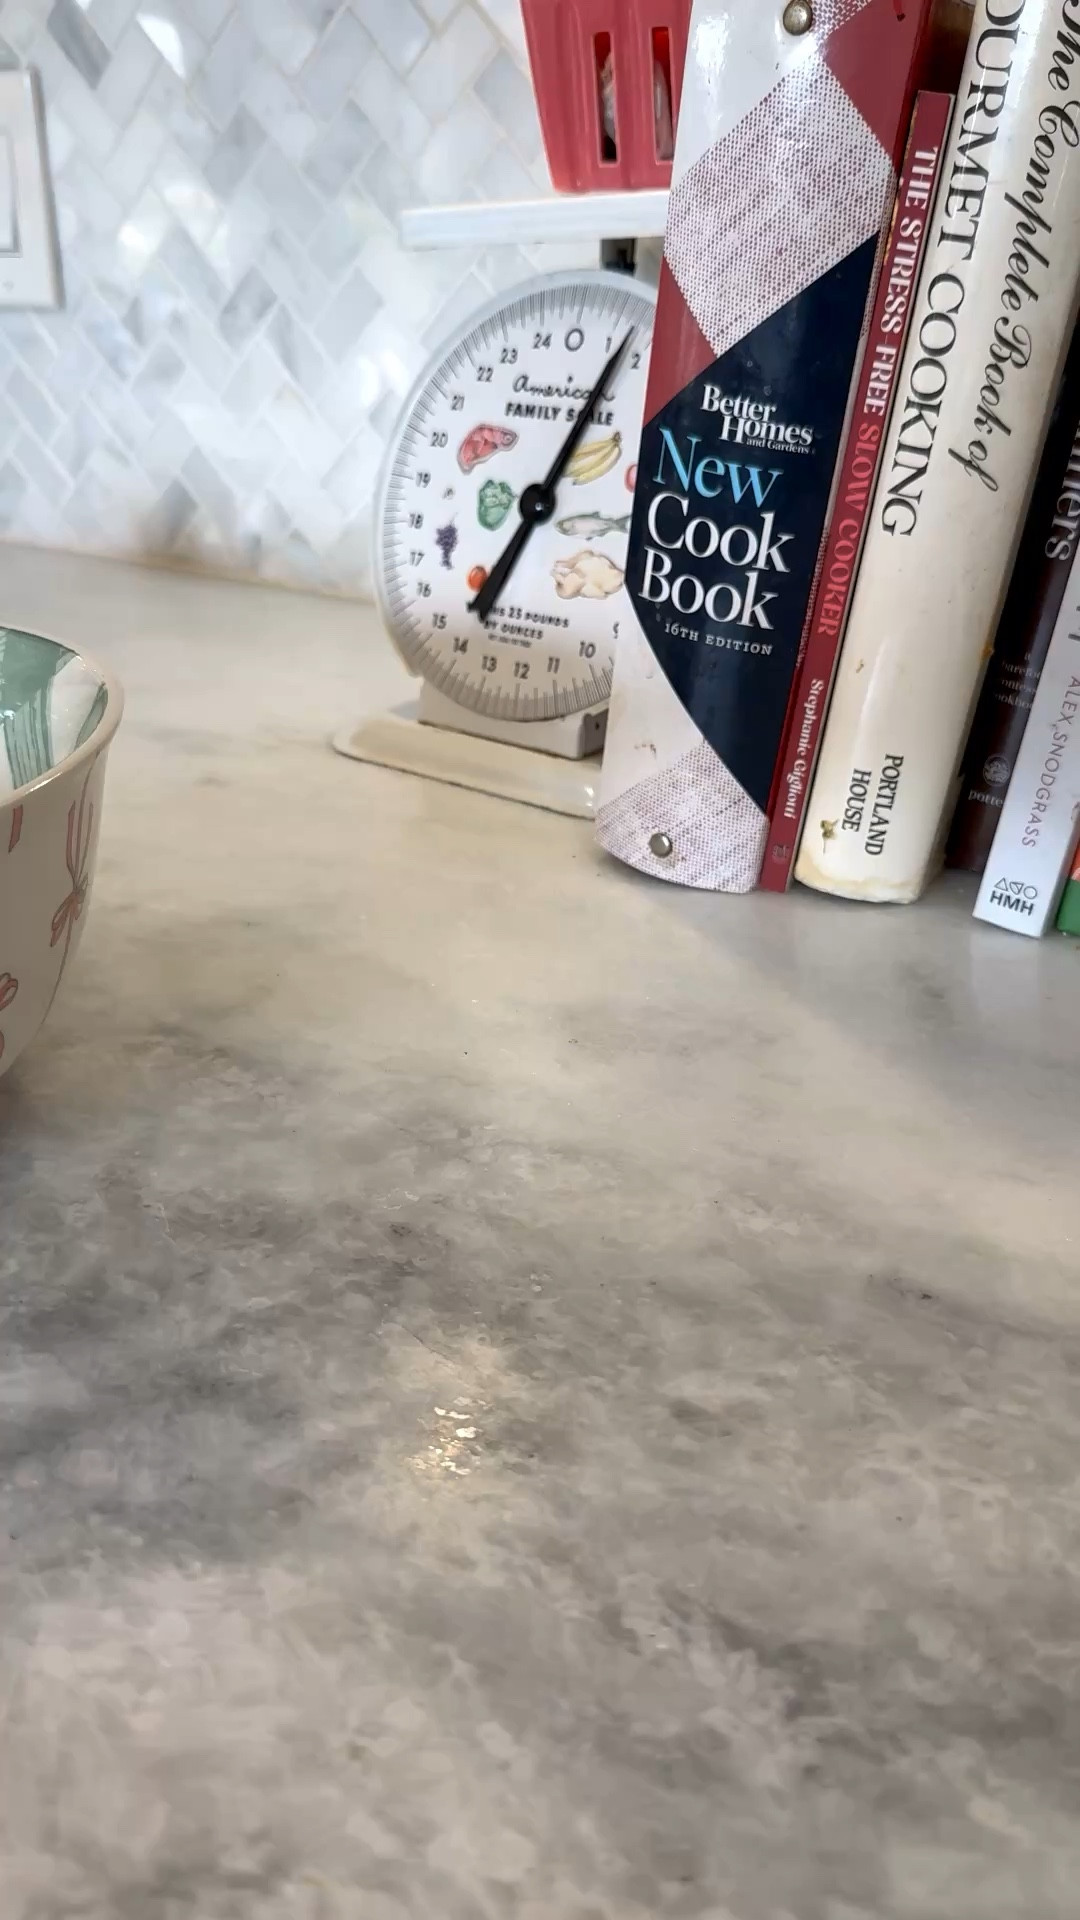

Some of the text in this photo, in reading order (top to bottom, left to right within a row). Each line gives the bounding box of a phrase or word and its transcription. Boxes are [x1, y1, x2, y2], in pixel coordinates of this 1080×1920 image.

[904, 147, 939, 211] THE
[1001, 101, 1080, 312] Complete
[532, 332, 553, 351] 24
[564, 327, 585, 352] 0
[500, 347, 519, 365] 23
[630, 352, 642, 370] 2
[476, 366, 494, 384] 22
[974, 316, 1033, 437] Book
[512, 374, 616, 403] America
[450, 395, 466, 412] 21
[504, 401, 615, 427] FAMILY SALE
[701, 384, 777, 423] Better
[881, 271, 967, 537] COOKING
[430, 431, 449, 449] 20
[719, 415, 815, 446] Homes
[746, 438, 810, 456] and Gardens
[652, 426, 785, 509] New
[844, 422, 880, 512] SLOW
[948, 440, 998, 493] of
[415, 471, 432, 489] 19
[408, 513, 424, 530] 18
[647, 490, 796, 574] Cook
[409, 551, 426, 567] 17
[416, 582, 432, 598] 16
[637, 545, 779, 631] Book
[817, 518, 860, 637] COOKER
[431, 612, 448, 631] 15
[524, 611, 570, 629] POUNDS
[453, 637, 470, 655] 14
[578, 640, 597, 660] 10
[664, 622, 774, 657] 16TH EDITION
[481, 656, 498, 674] 13
[513, 661, 531, 681] 12
[547, 656, 561, 675] 11
[797, 678, 825, 757] Stephanie
[1021, 675, 1080, 848] ALEX SNODGRASS
[841, 768, 873, 833] HOUSE
[864, 753, 905, 856] PORTLAND
[968, 789, 1004, 807] potte
[989, 890, 1034, 917] HMH
